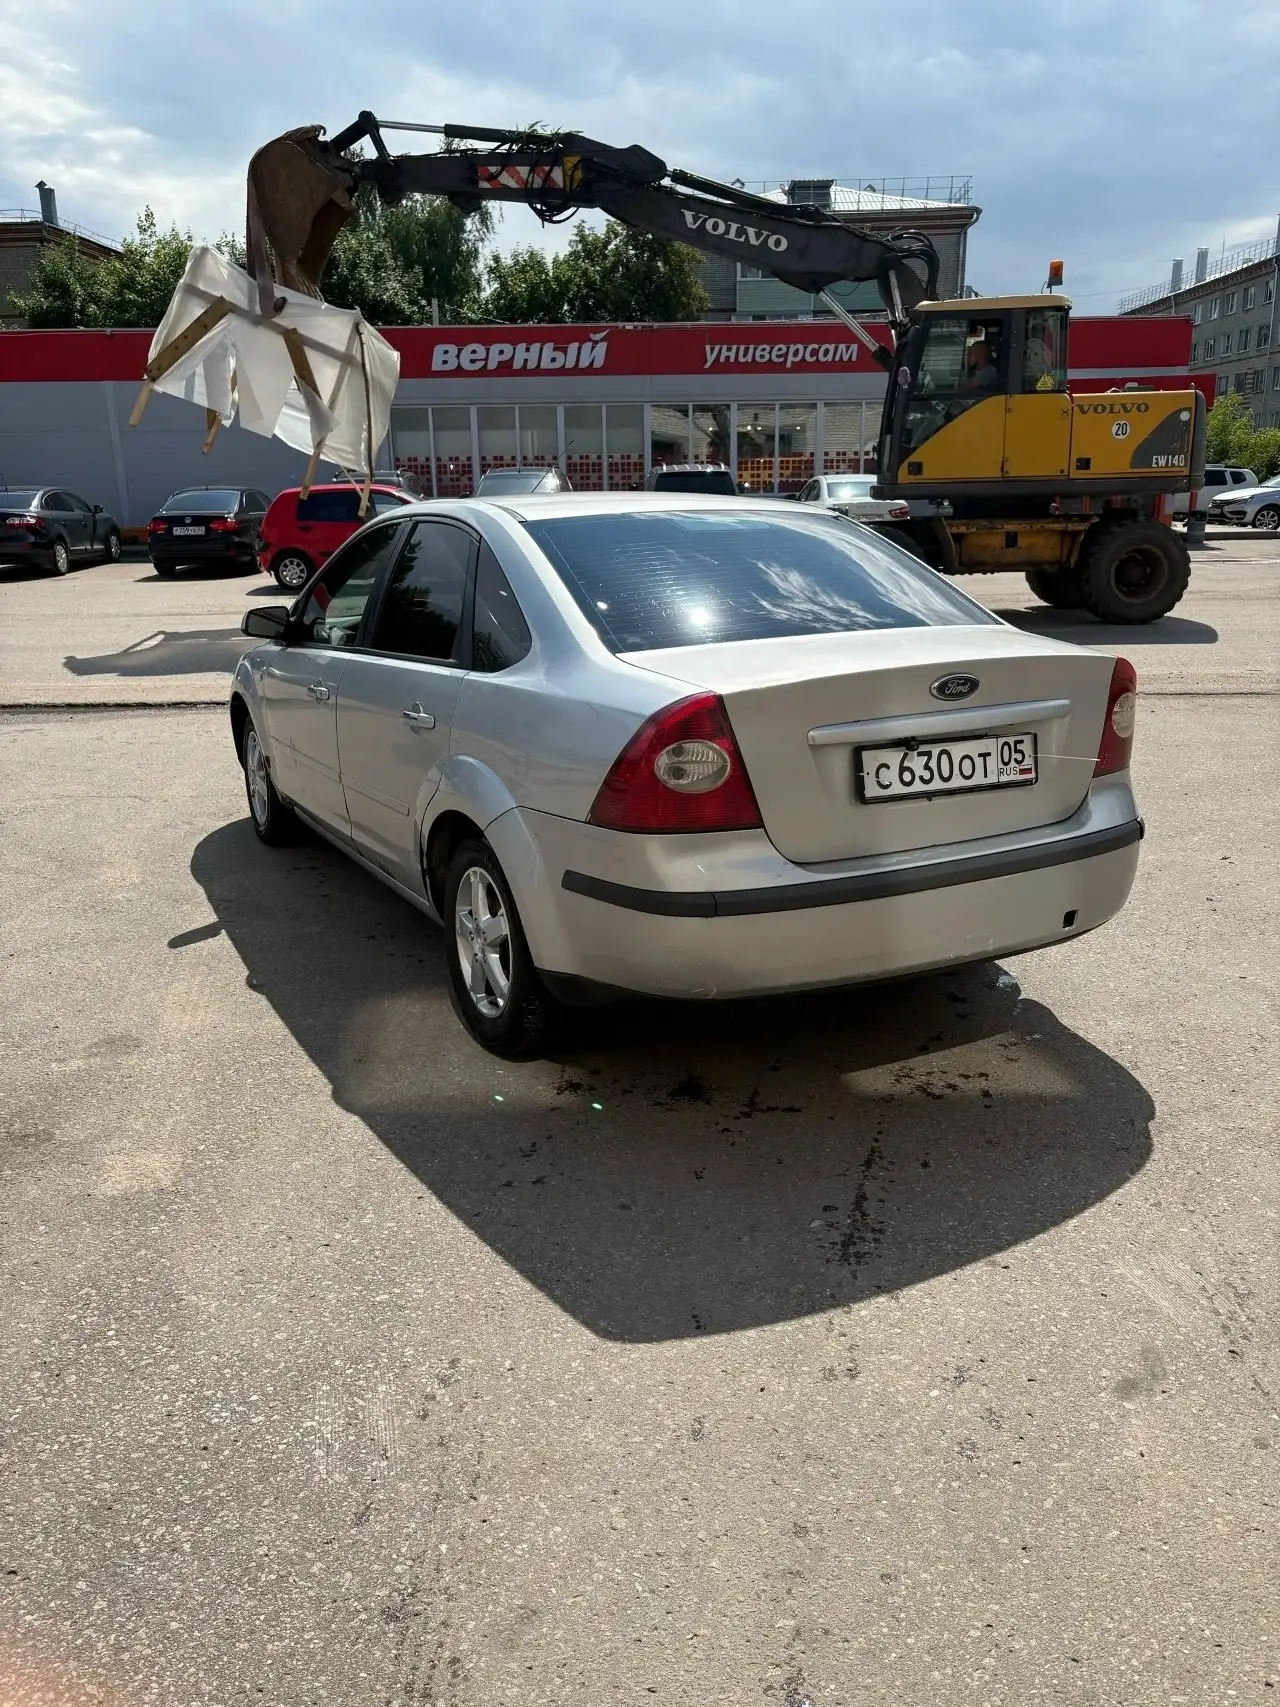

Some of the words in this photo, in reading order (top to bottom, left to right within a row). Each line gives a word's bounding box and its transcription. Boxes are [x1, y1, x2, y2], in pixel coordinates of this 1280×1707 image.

[681, 209, 788, 252] VOLVO
[704, 343, 858, 369] универсам
[1076, 402, 1150, 415] VOLVO
[1115, 422, 1128, 436] 20
[1152, 454, 1185, 467] EW140
[945, 679, 971, 694] Ford
[1000, 739, 1026, 766] 05
[1000, 766, 1018, 777] RUS
